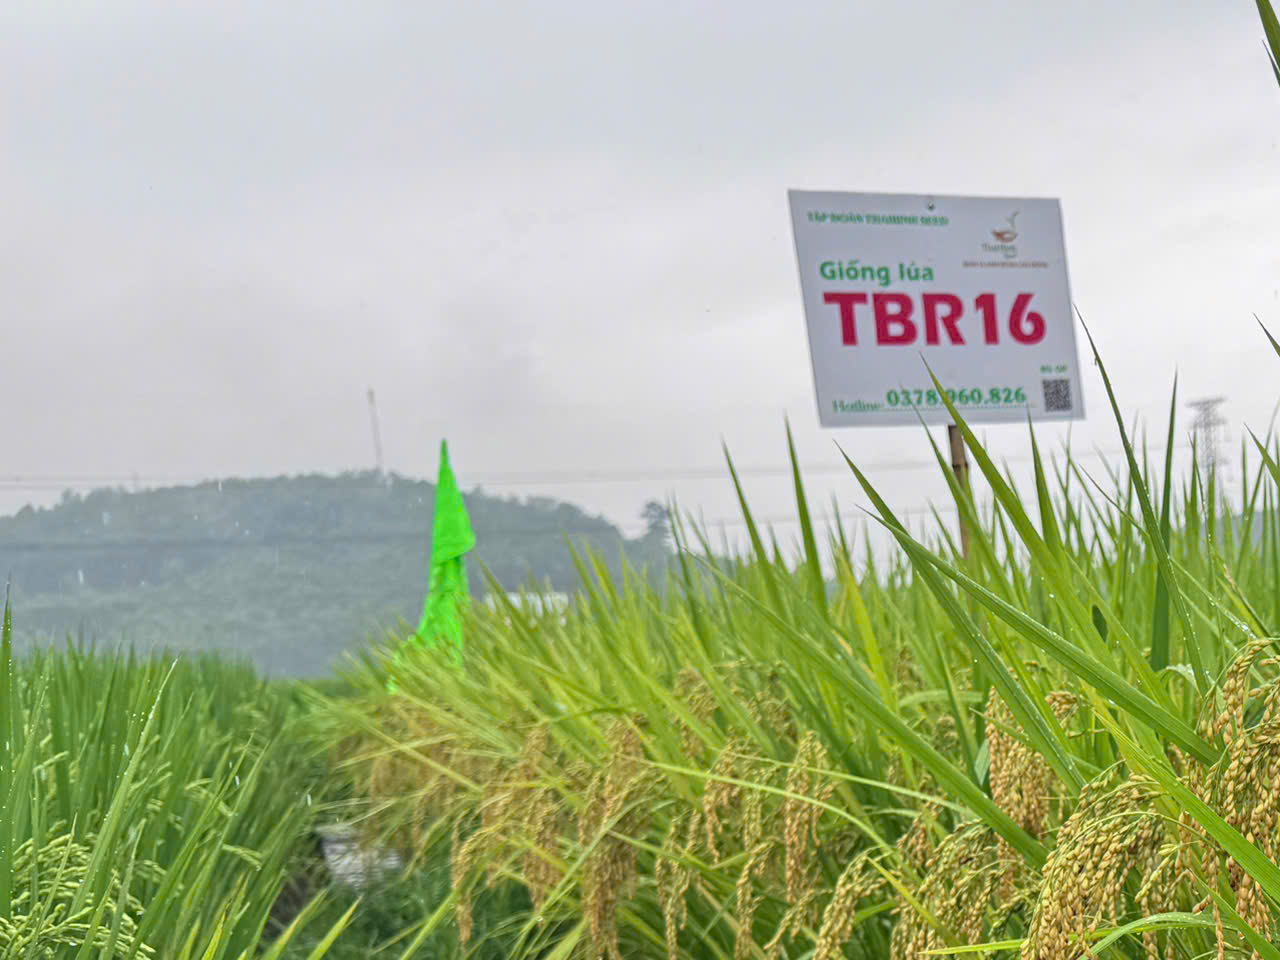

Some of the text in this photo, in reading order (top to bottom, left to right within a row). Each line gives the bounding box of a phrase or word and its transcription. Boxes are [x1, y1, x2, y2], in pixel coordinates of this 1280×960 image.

[819, 259, 935, 287] Giống lúa
[823, 292, 1047, 347] TBR16
